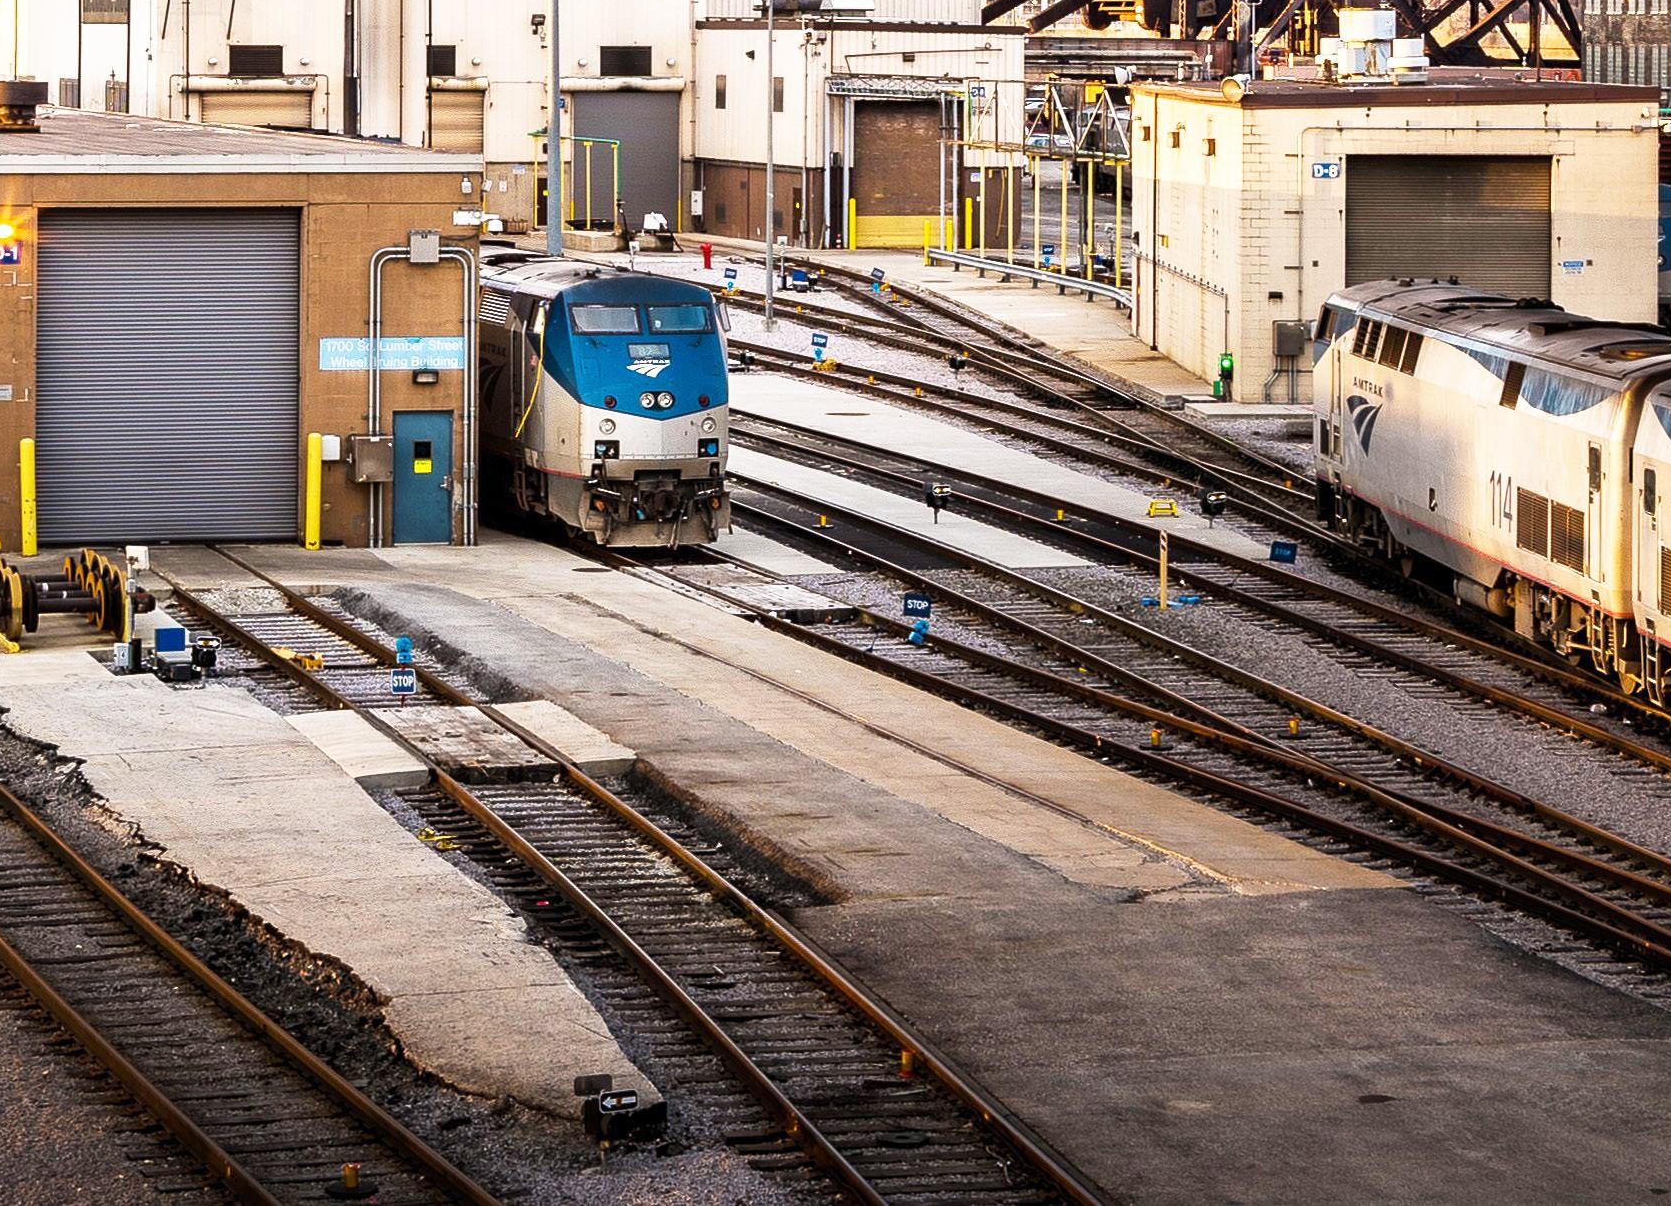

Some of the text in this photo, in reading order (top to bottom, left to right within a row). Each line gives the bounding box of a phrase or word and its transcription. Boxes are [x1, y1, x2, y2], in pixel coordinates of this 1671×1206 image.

[1313, 164, 1339, 178] D-8
[326, 341, 354, 352] 1700
[379, 340, 425, 352] Lumber
[410, 356, 459, 370] Building
[1353, 376, 1384, 398] AMTRAK
[1489, 469, 1513, 533] 114
[906, 599, 929, 610] STOP
[393, 675, 414, 688] STOP
